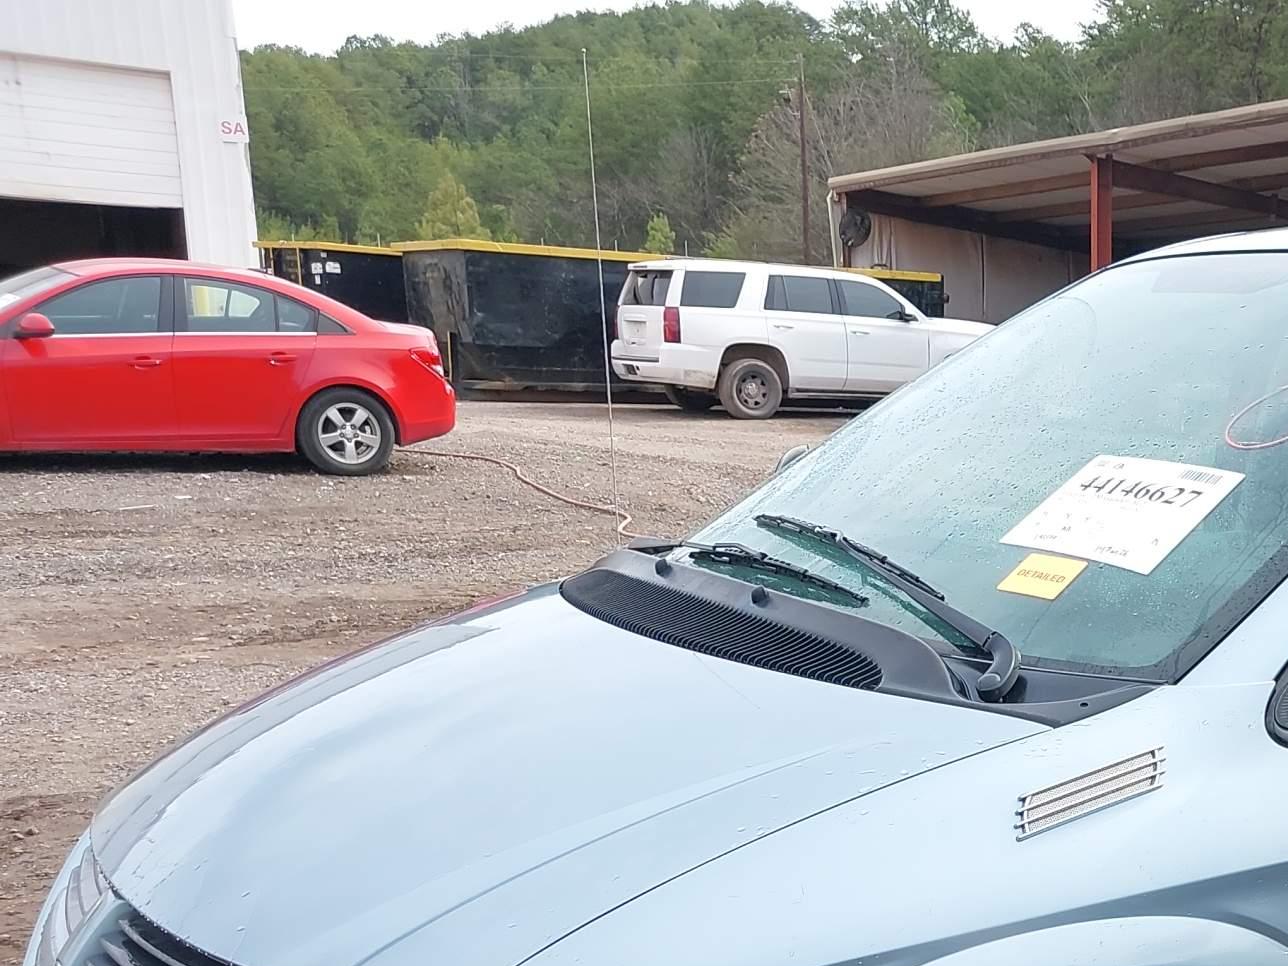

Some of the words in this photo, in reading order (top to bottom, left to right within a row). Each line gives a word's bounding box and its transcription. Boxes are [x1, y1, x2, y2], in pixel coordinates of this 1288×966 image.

[220, 120, 246, 136] SA
[1080, 475, 1204, 507] 44146627
[1017, 568, 1066, 584] DETAILED
